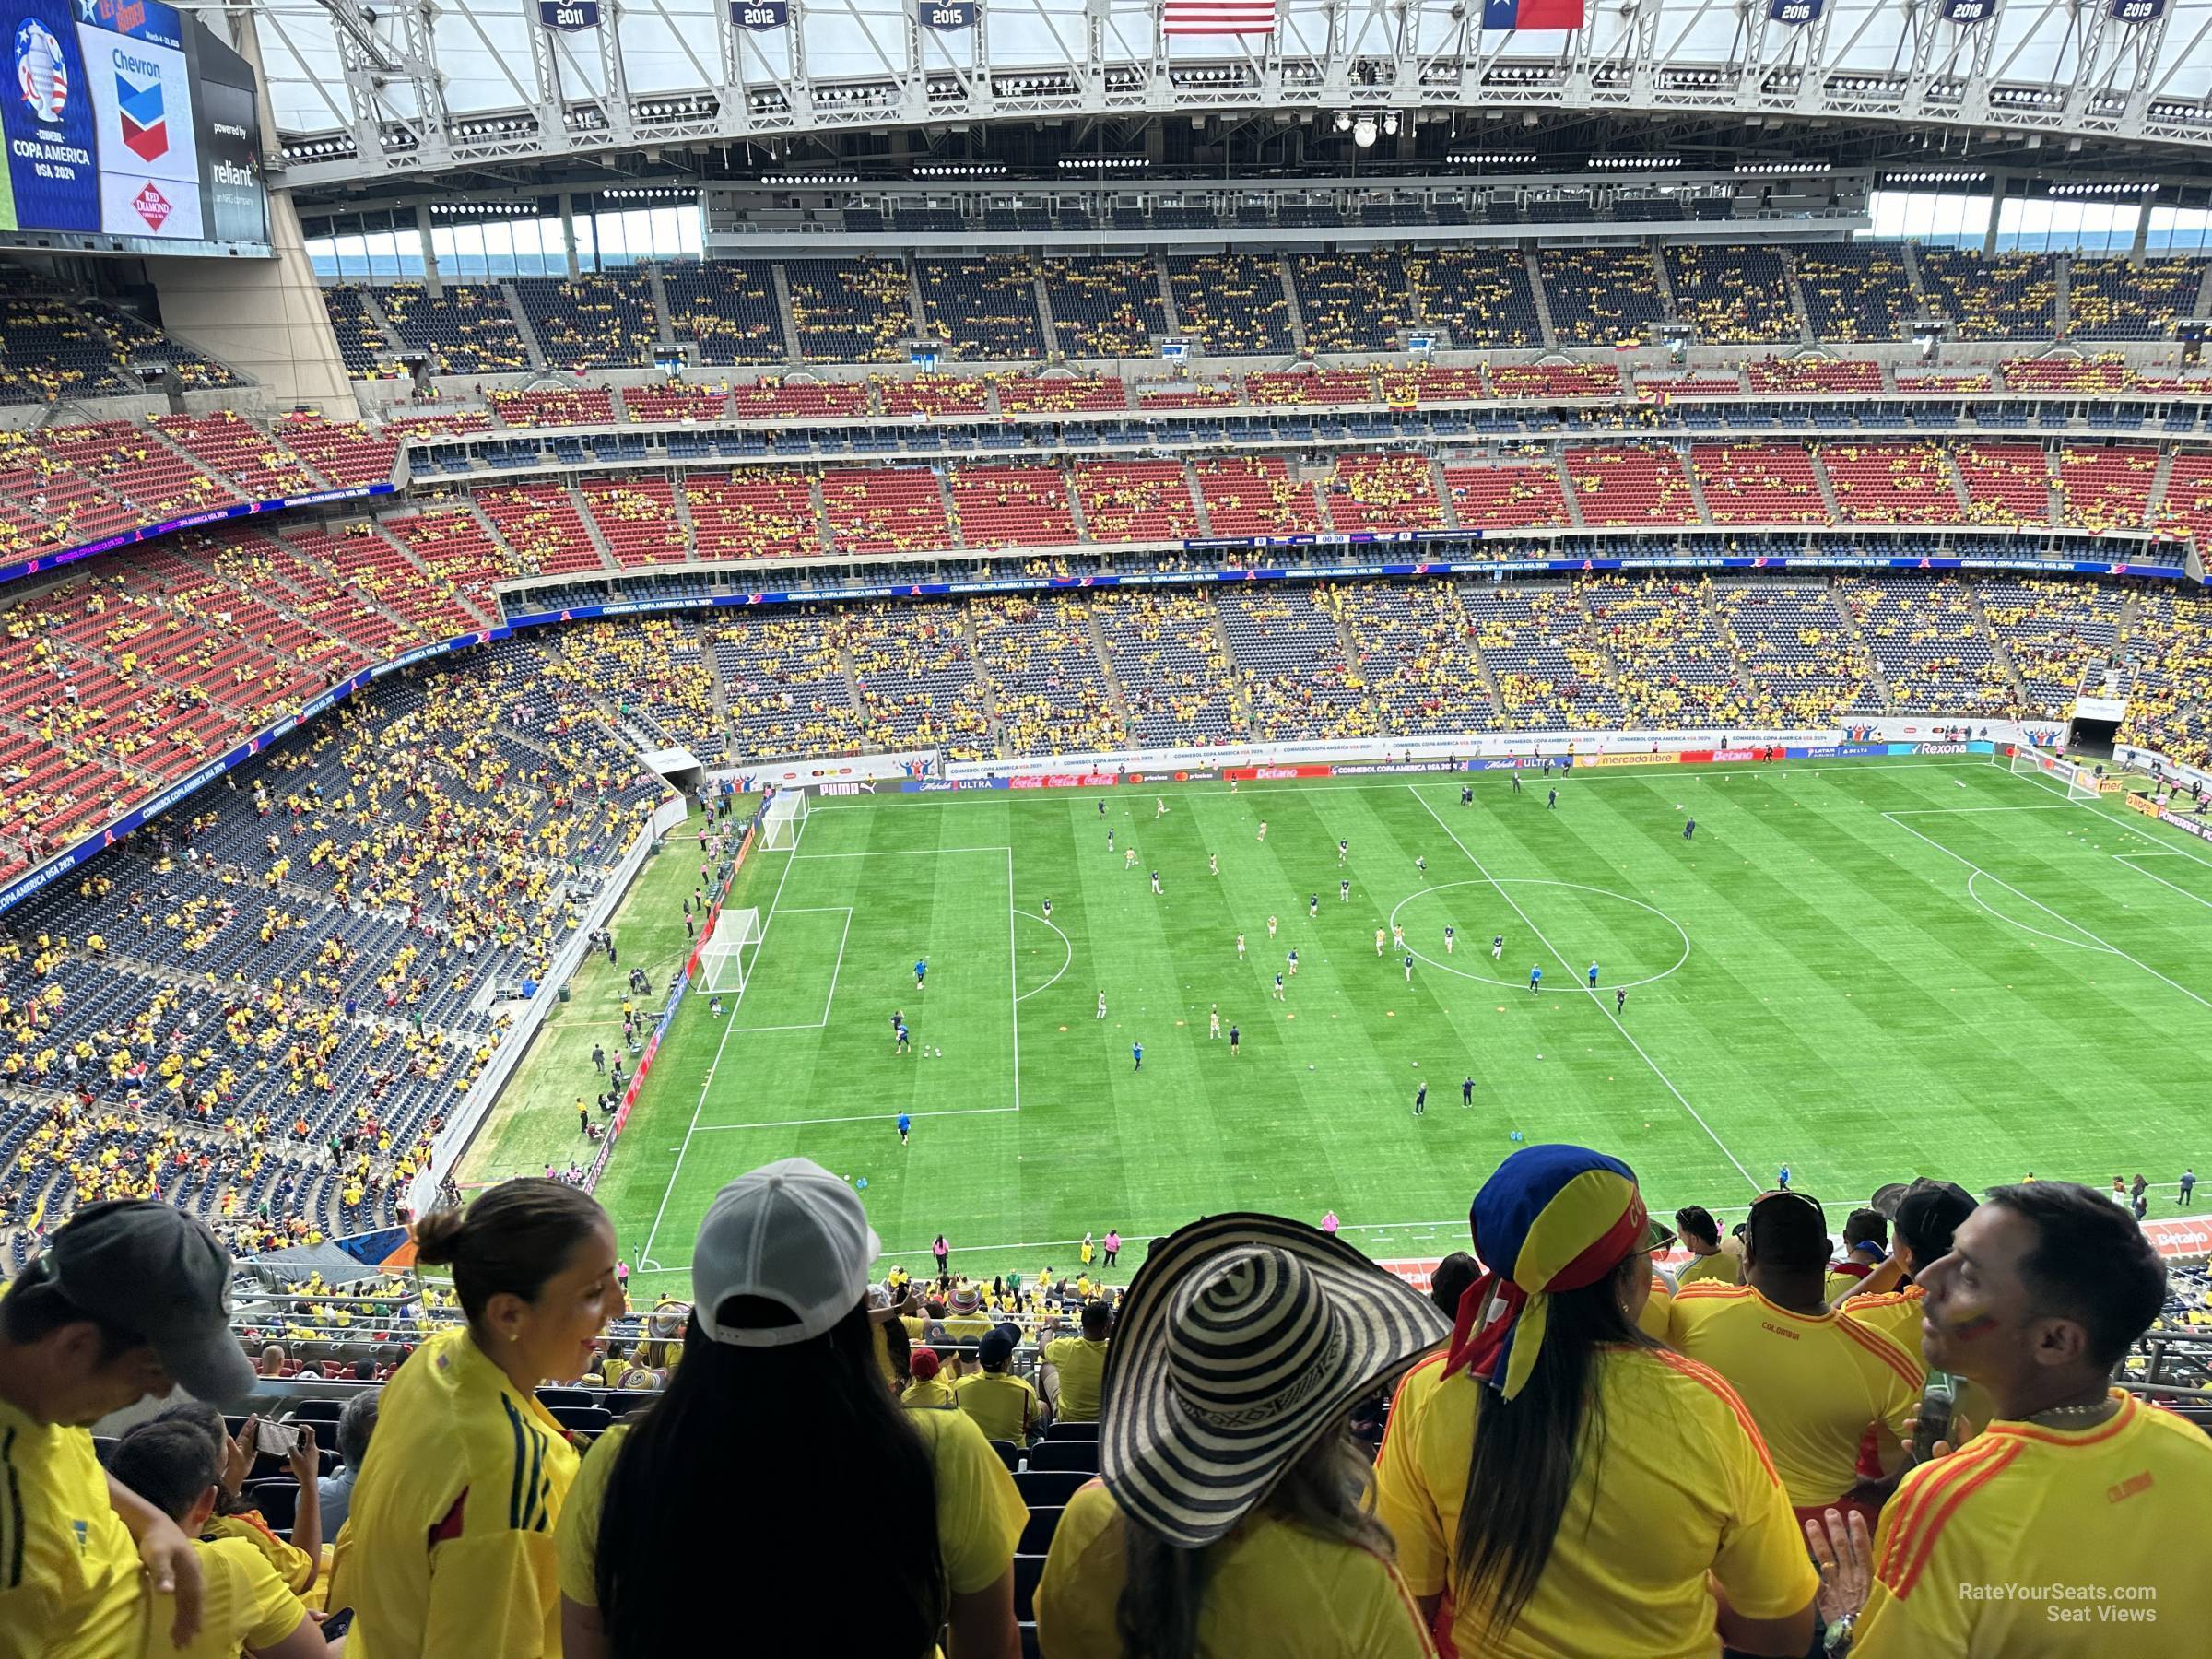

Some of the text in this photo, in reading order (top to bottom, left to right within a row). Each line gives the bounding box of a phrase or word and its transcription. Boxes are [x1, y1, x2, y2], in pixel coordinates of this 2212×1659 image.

[557, 8, 584, 25] 2011
[744, 9, 775, 24] 2012
[933, 9, 963, 24] 2015
[1782, 5, 1810, 19] 2016
[1953, 4, 1983, 18] 2018
[2123, 2, 2153, 17] 2019
[112, 48, 160, 78] Chevron
[214, 123, 247, 140] powered by
[13, 140, 90, 166] COPA AMERICA
[35, 163, 76, 181] USA 2024
[214, 159, 253, 187] reliant
[145, 190, 159, 202] RED
[136, 199, 169, 214] DIAMOND
[1922, 742, 1967, 755] Rexona
[1603, 754, 1672, 764] mercado libre
[1712, 751, 1753, 761] Betano
[1256, 769, 1298, 778] Betano
[1338, 765, 1376, 773] CONMEBOL
[819, 782, 859, 796] PUMA
[959, 780, 993, 789] ULTRA
[2101, 782, 2123, 791] mer
[2134, 798, 2152, 811] libre
[16, 873, 47, 895] AMERICA
[46, 866, 60, 879] USA
[59, 855, 75, 871] 2024
[2157, 1232, 2208, 1246] Betano
[1401, 1272, 1432, 1283] etan
[1761, 1321, 1800, 1341] COLOMBIA
